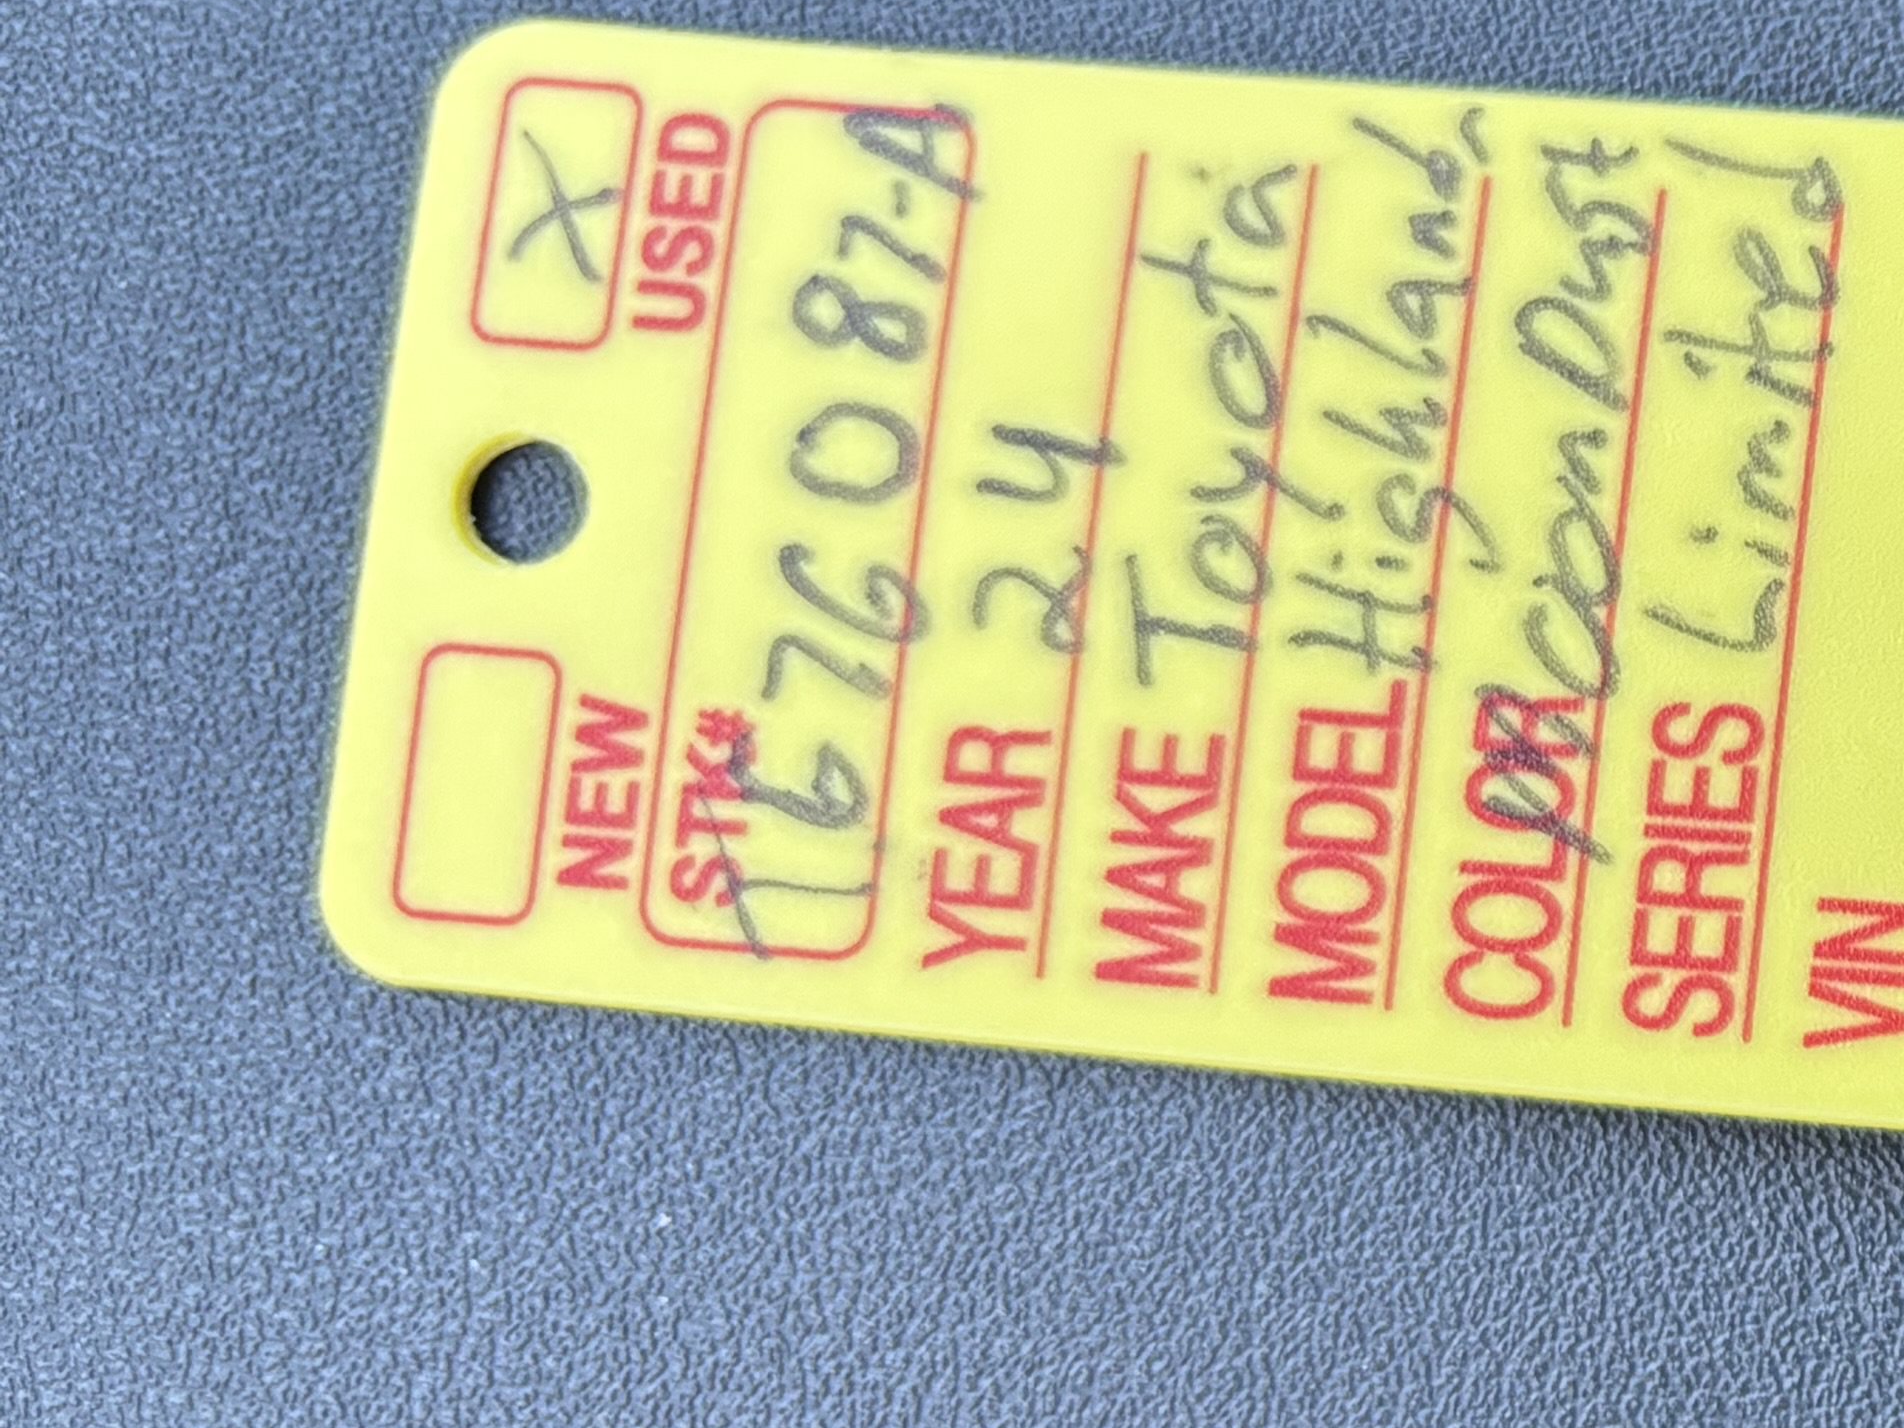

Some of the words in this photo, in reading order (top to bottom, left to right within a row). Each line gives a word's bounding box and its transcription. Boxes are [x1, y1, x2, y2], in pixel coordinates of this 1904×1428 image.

[632, 112, 730, 333] USED
[1127, 164, 1344, 688] Toyota
[1644, 136, 1844, 654] Limited
[555, 693, 653, 892] NEW
[669, 706, 756, 907] STK#
[921, 724, 1054, 969] YEAR
[1094, 726, 1231, 989] MAKE
[1268, 677, 1408, 1004] MODEL
[1443, 694, 1593, 1022] COLOR
[1621, 700, 1765, 1038] SERIES
